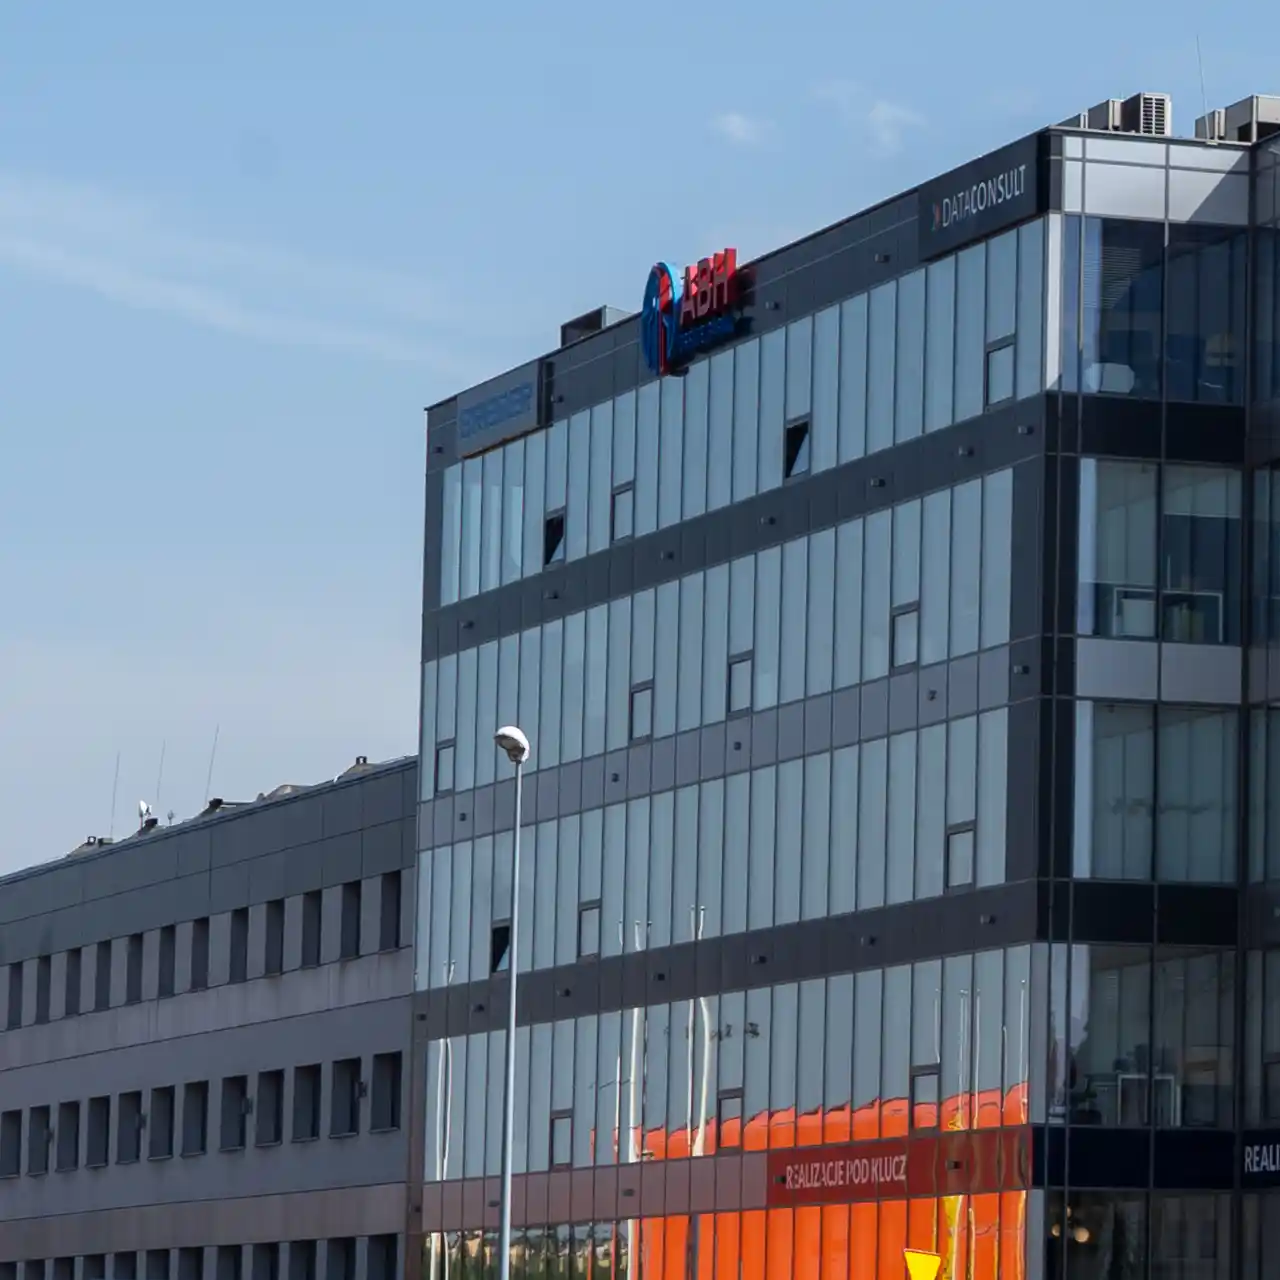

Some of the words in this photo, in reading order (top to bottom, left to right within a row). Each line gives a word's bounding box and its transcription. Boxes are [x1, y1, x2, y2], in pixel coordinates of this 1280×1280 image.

[942, 165, 1026, 228] DATACONSULT
[680, 248, 736, 325] ABH
[785, 1160, 844, 1190] REALIZACJE
[846, 1158, 869, 1185] POD
[871, 1154, 907, 1184] KLUCZ
